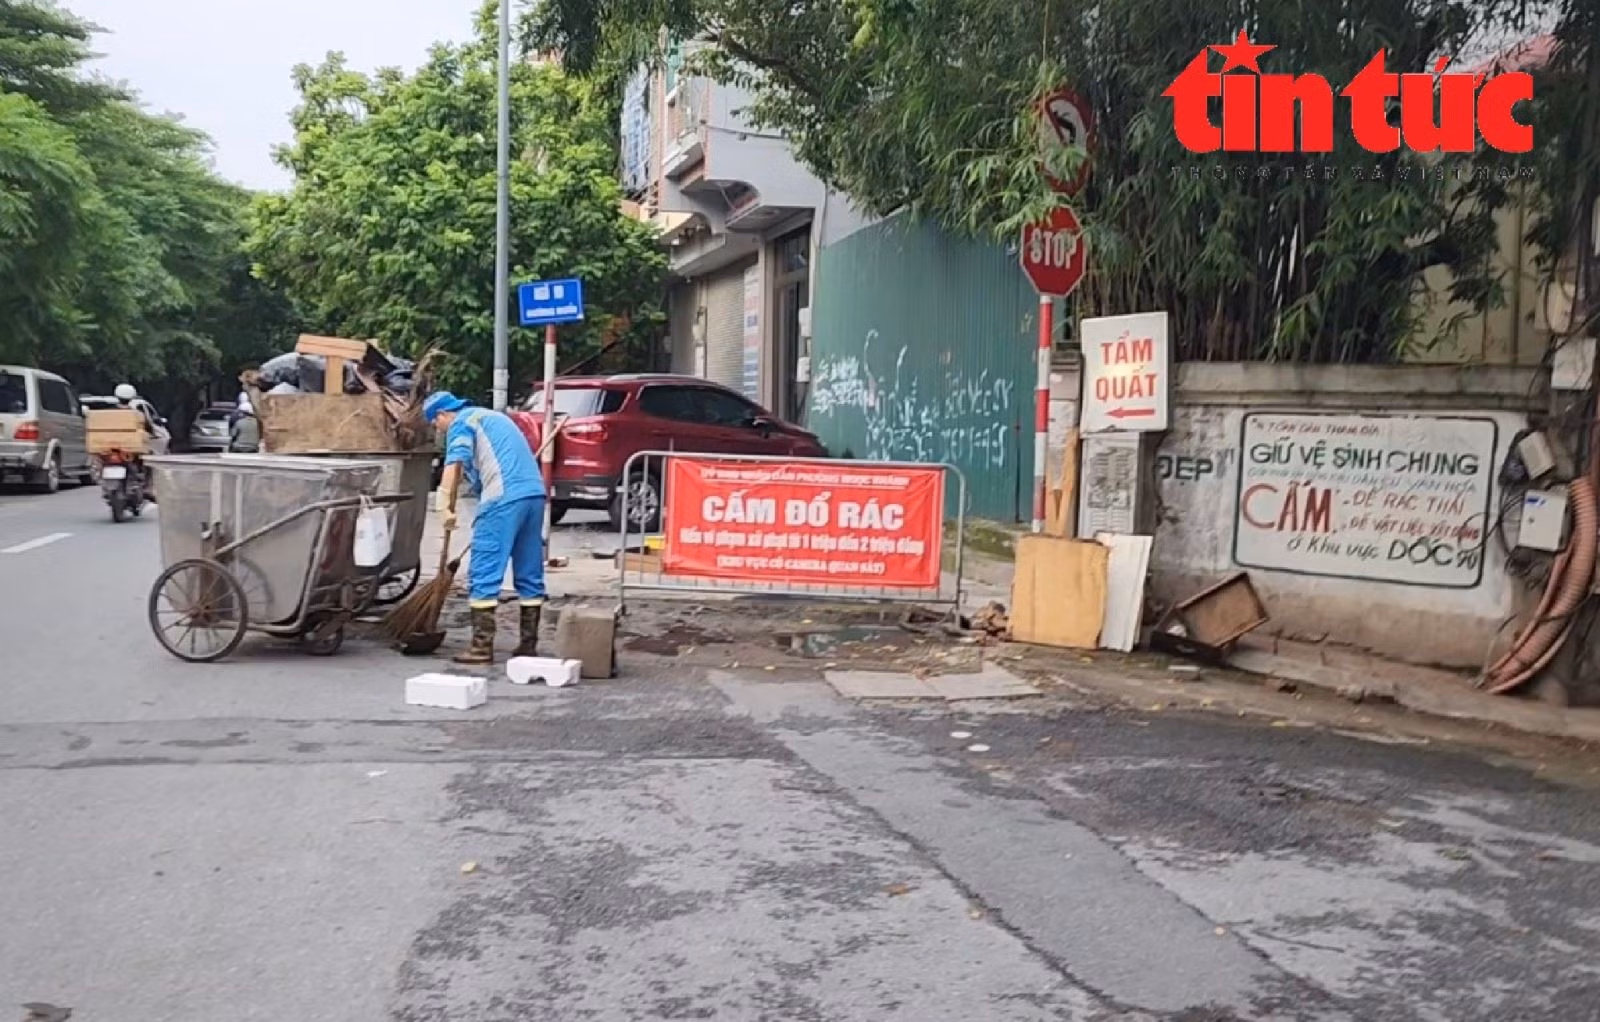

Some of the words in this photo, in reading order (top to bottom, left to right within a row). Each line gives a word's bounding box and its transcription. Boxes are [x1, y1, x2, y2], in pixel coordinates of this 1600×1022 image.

[1030, 228, 1077, 269] STOP
[1250, 437, 1295, 465] GIỮ
[1300, 439, 1327, 470] VỆ
[1386, 450, 1479, 476] CHUNG
[702, 489, 776, 525] CẤM
[784, 491, 832, 528] ĐỔ
[837, 497, 904, 531] RÁC
[1387, 536, 1454, 566] DỐC
